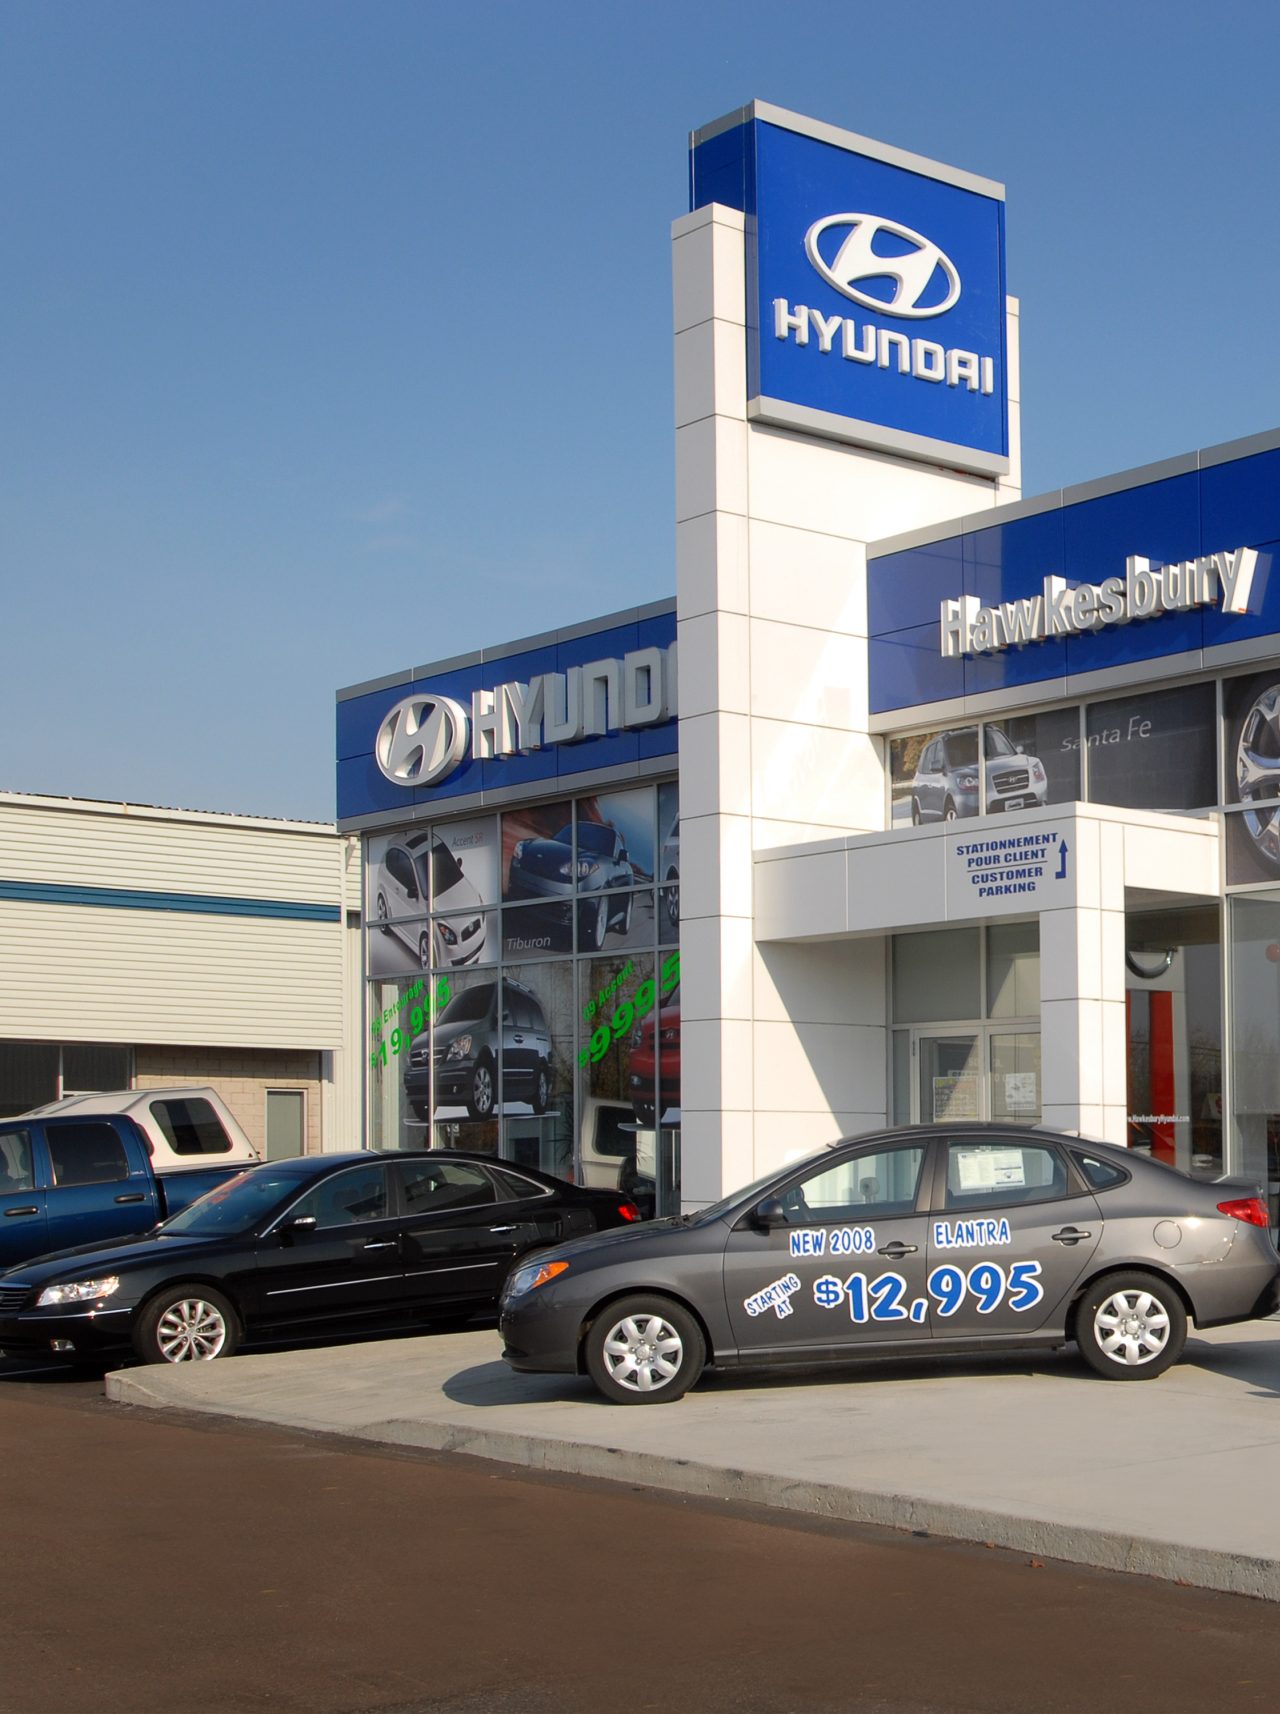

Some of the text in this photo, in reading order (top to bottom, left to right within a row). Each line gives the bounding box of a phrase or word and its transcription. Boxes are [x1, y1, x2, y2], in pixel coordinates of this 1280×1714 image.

[774, 297, 994, 396] HYUNDAI
[941, 547, 1259, 657] Hawkesbury
[471, 641, 679, 760] HYUND
[1060, 716, 1152, 751] Santa Fe
[956, 832, 1058, 856] STATIONNEMENT
[967, 848, 1048, 868] POUR CLIENT
[971, 866, 1043, 885] CUSTOMER
[979, 881, 1036, 897] PARKING
[506, 935, 551, 951] Tiburon
[790, 1218, 1010, 1255] NEW 2008 ELANTRA
[745, 1274, 801, 1316] STARTING
[776, 1299, 793, 1318] AT
[813, 1261, 1043, 1323] $12,995
